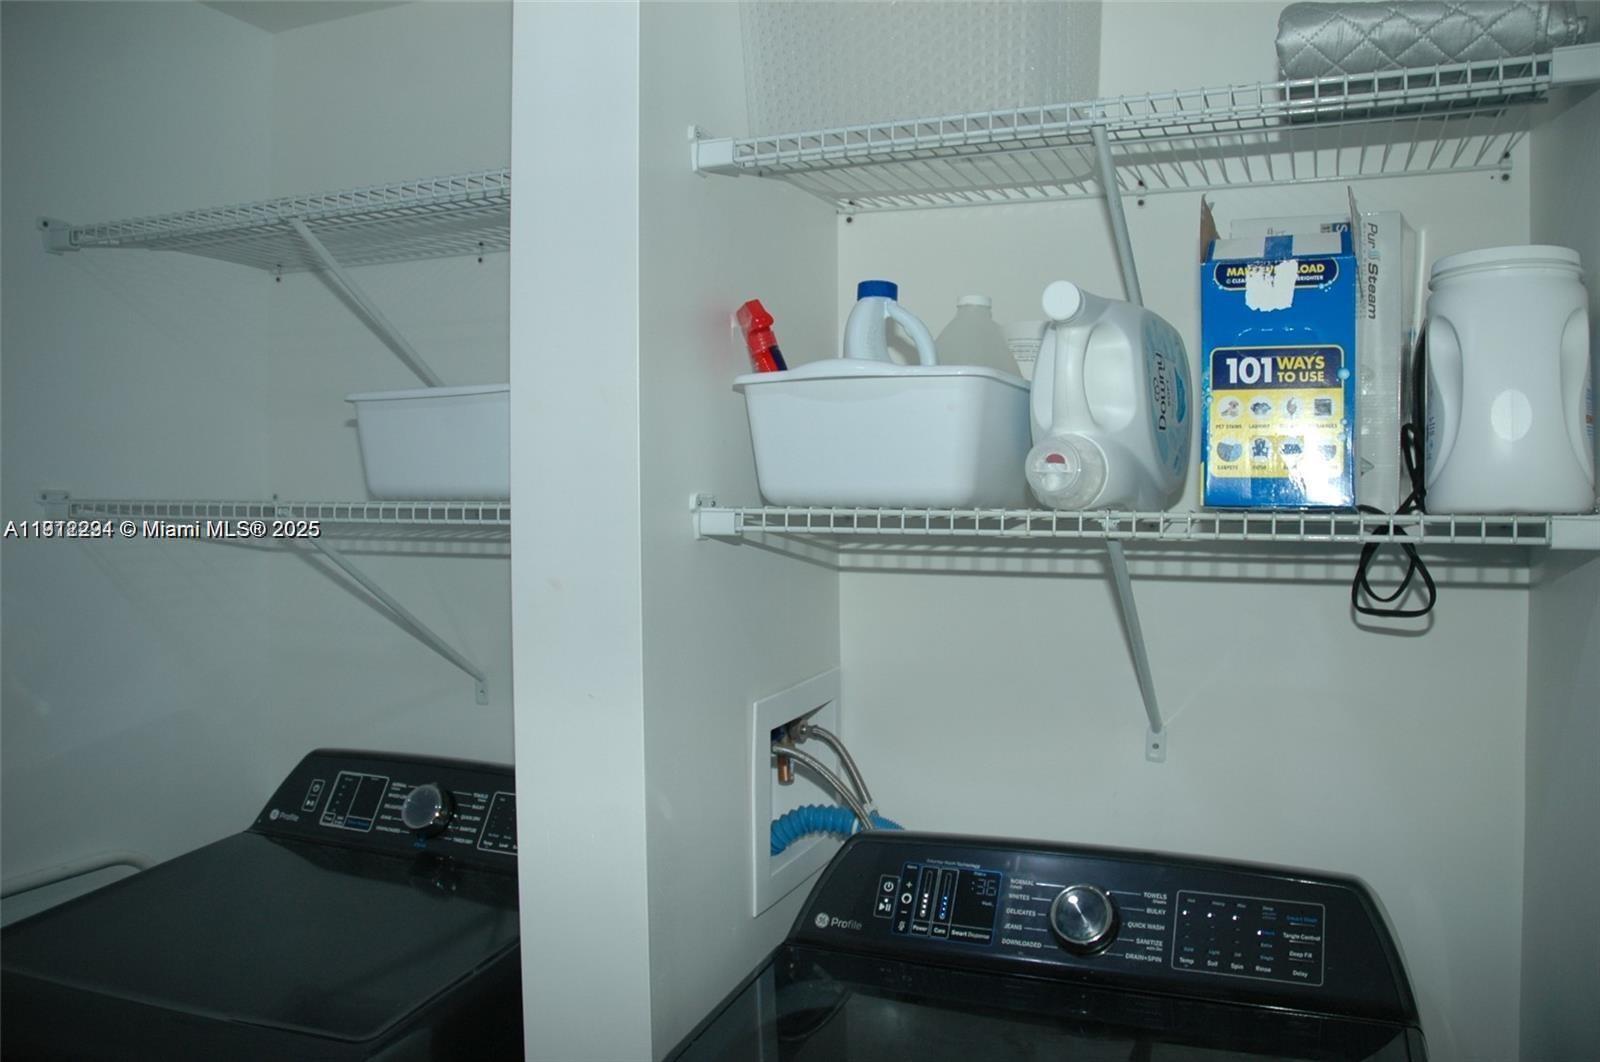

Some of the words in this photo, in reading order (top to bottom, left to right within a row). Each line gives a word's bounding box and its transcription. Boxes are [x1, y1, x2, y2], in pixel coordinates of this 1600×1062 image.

[1367, 222, 1379, 250] Pur
[1367, 262, 1379, 320] Steam
[1226, 356, 1273, 384] 101
[1276, 355, 1326, 370] WAYS
[1277, 371, 1296, 383] TO
[1299, 371, 1326, 383] USE
[1155, 352, 1167, 431] Downy
[1010, 878, 1035, 887] NORMAL
[1008, 893, 1031, 901] WHITES
[1143, 891, 1168, 900] TOWELS
[1005, 907, 1036, 917] DELICATES
[1146, 907, 1167, 916] BULKY
[830, 917, 863, 931] Profile
[912, 924, 928, 933] Power
[1003, 922, 1023, 931] JEANS
[1127, 921, 1147, 930] QUICK
[1147, 922, 1165, 931] WASH
[951, 929, 967, 937] Smart
[1283, 931, 1300, 941] Tangle
[1300, 933, 1321, 942] Control
[1001, 938, 1042, 949] DOWNLOADED
[1135, 937, 1164, 947] SANITIZE
[1125, 952, 1163, 963] DRAIN+SPIN
[1179, 956, 1195, 965] Temp
[1230, 962, 1244, 970] Spin
[1255, 965, 1272, 973] Rinse
[1292, 969, 1309, 978] Delay
